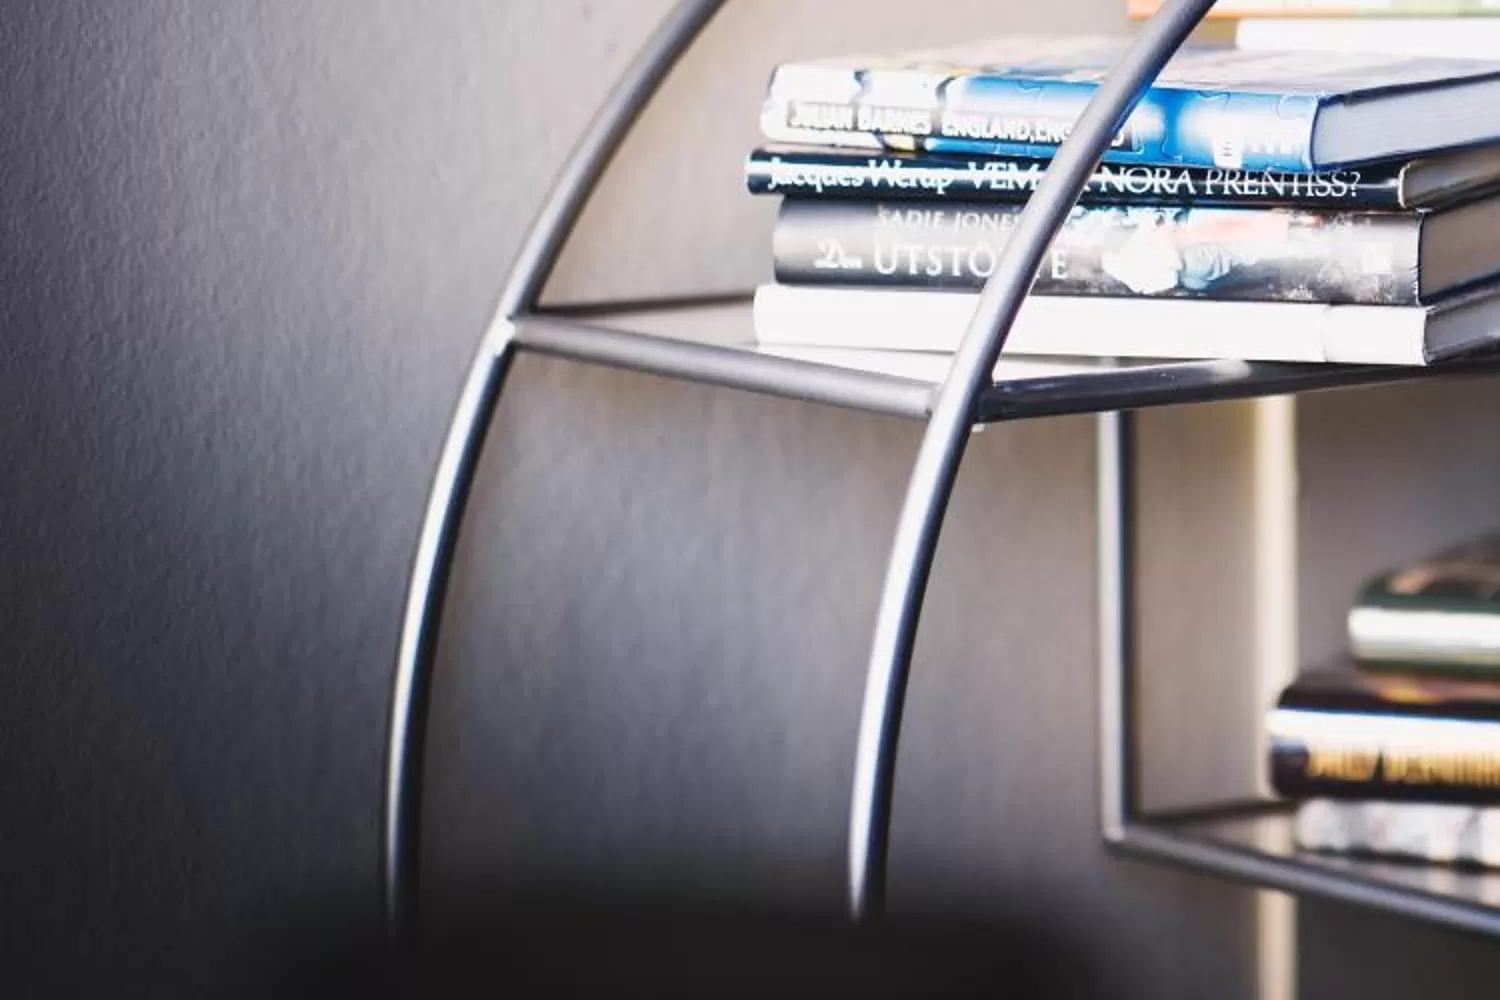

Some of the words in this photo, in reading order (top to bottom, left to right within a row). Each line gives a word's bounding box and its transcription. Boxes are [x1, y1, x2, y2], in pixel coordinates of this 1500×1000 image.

[768, 157, 863, 193] Jacques
[967, 161, 1041, 191] VEM
[1101, 165, 1196, 194] NORA
[1204, 167, 1361, 198] PRENTISS?
[873, 232, 1070, 279] UTSTÖE
